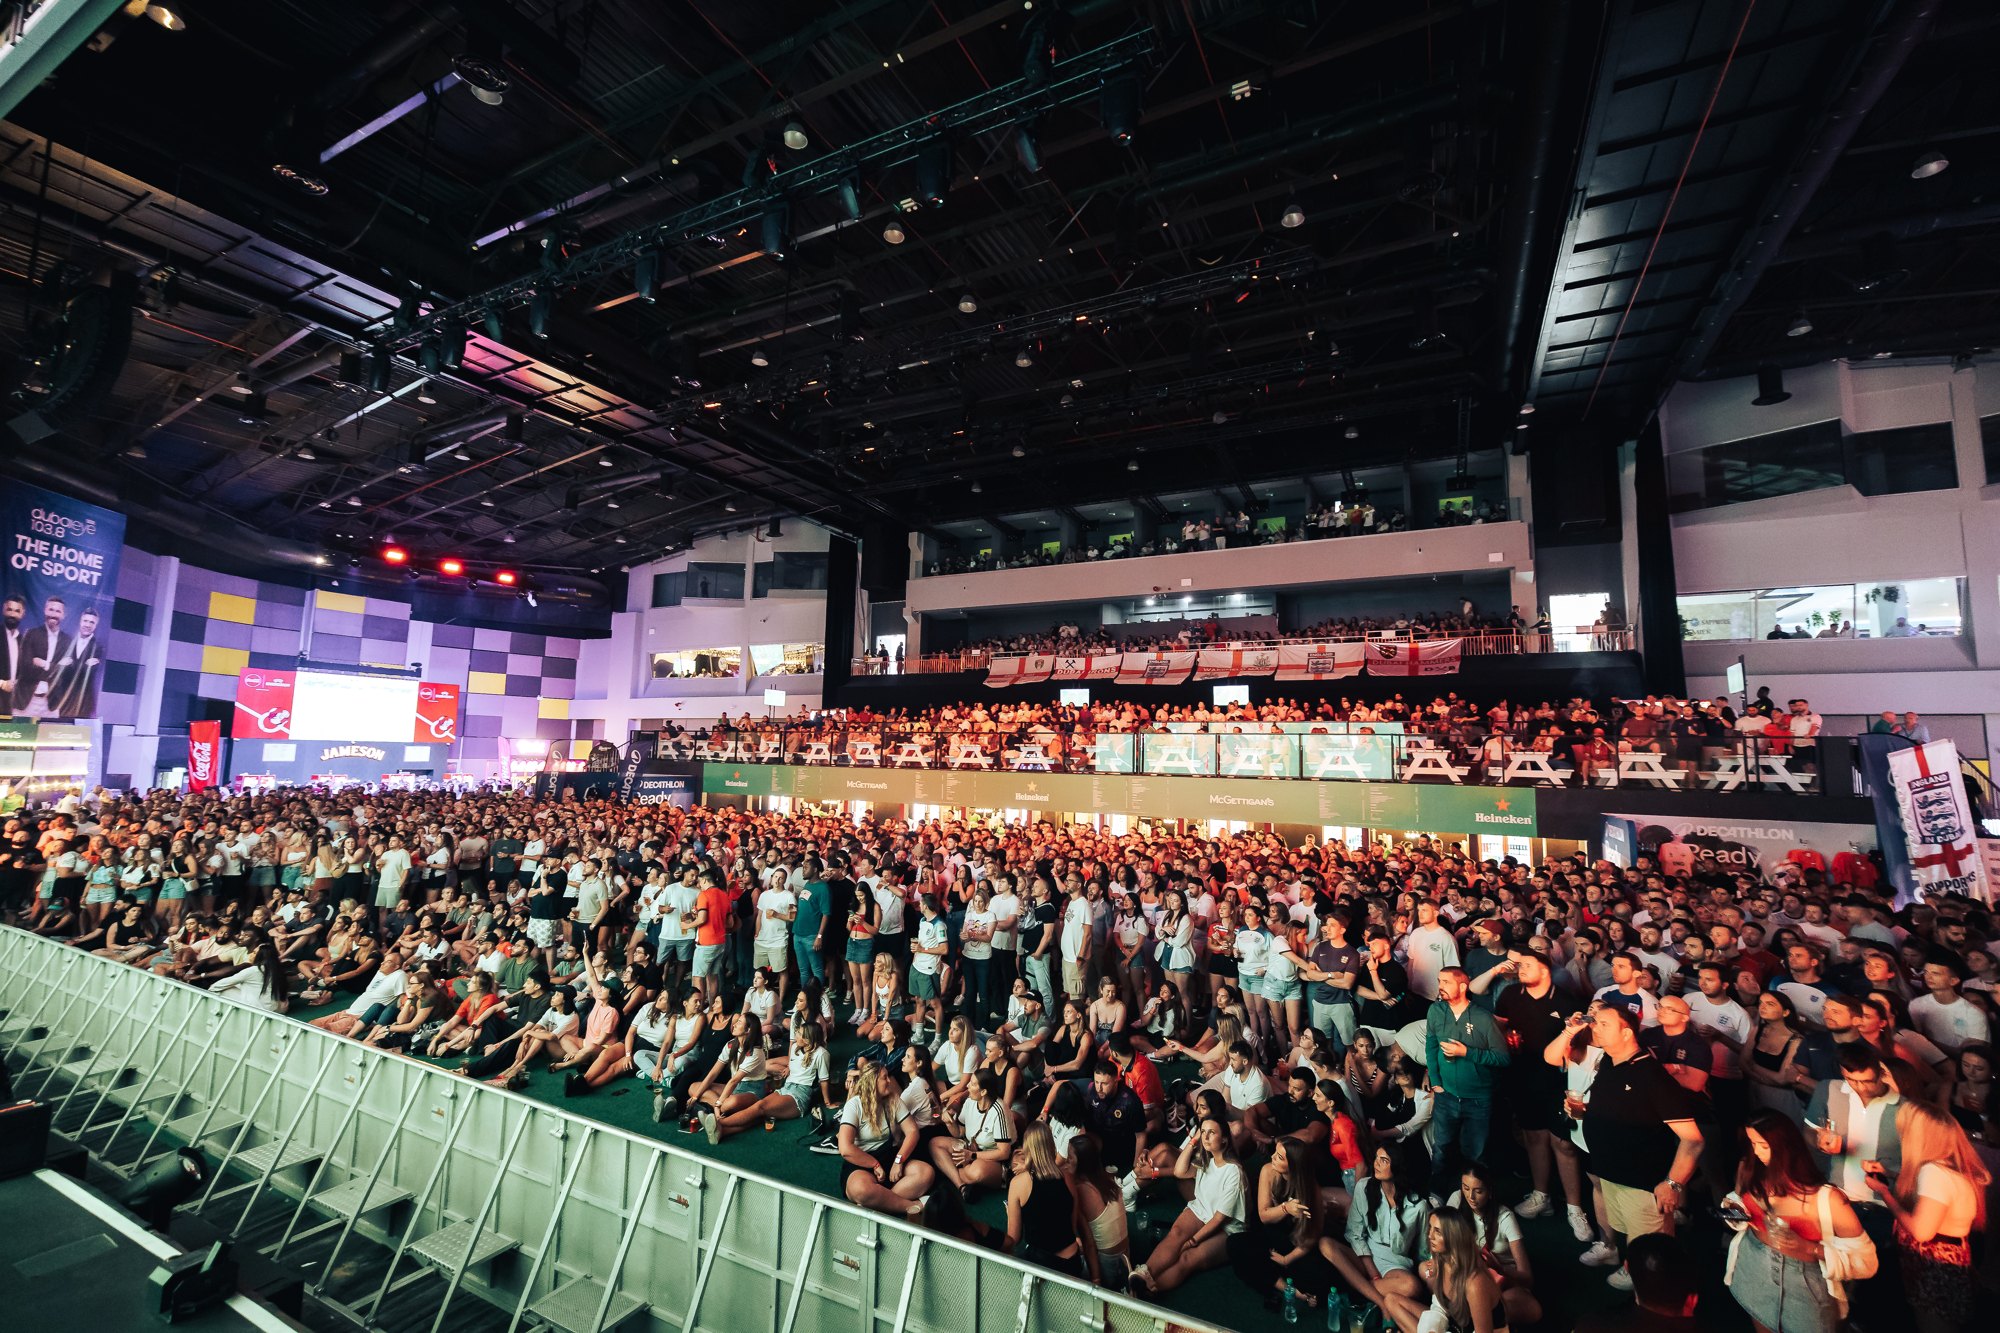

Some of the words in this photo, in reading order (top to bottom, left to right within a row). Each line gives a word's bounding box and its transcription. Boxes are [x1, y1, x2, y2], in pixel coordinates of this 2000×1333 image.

[31, 519, 65, 538] 103.8
[15, 534, 51, 556] THE
[52, 544, 104, 569] HOME
[11, 553, 40, 571] OF
[41, 560, 102, 585] SPORT
[320, 745, 386, 761] JAMESON
[621, 764, 637, 805] DECATH
[643, 781, 685, 789] DECATHLON
[1015, 792, 1049, 802] Heineken
[1475, 812, 1532, 824] Heineken
[1696, 825, 1794, 841] DECATHLON
